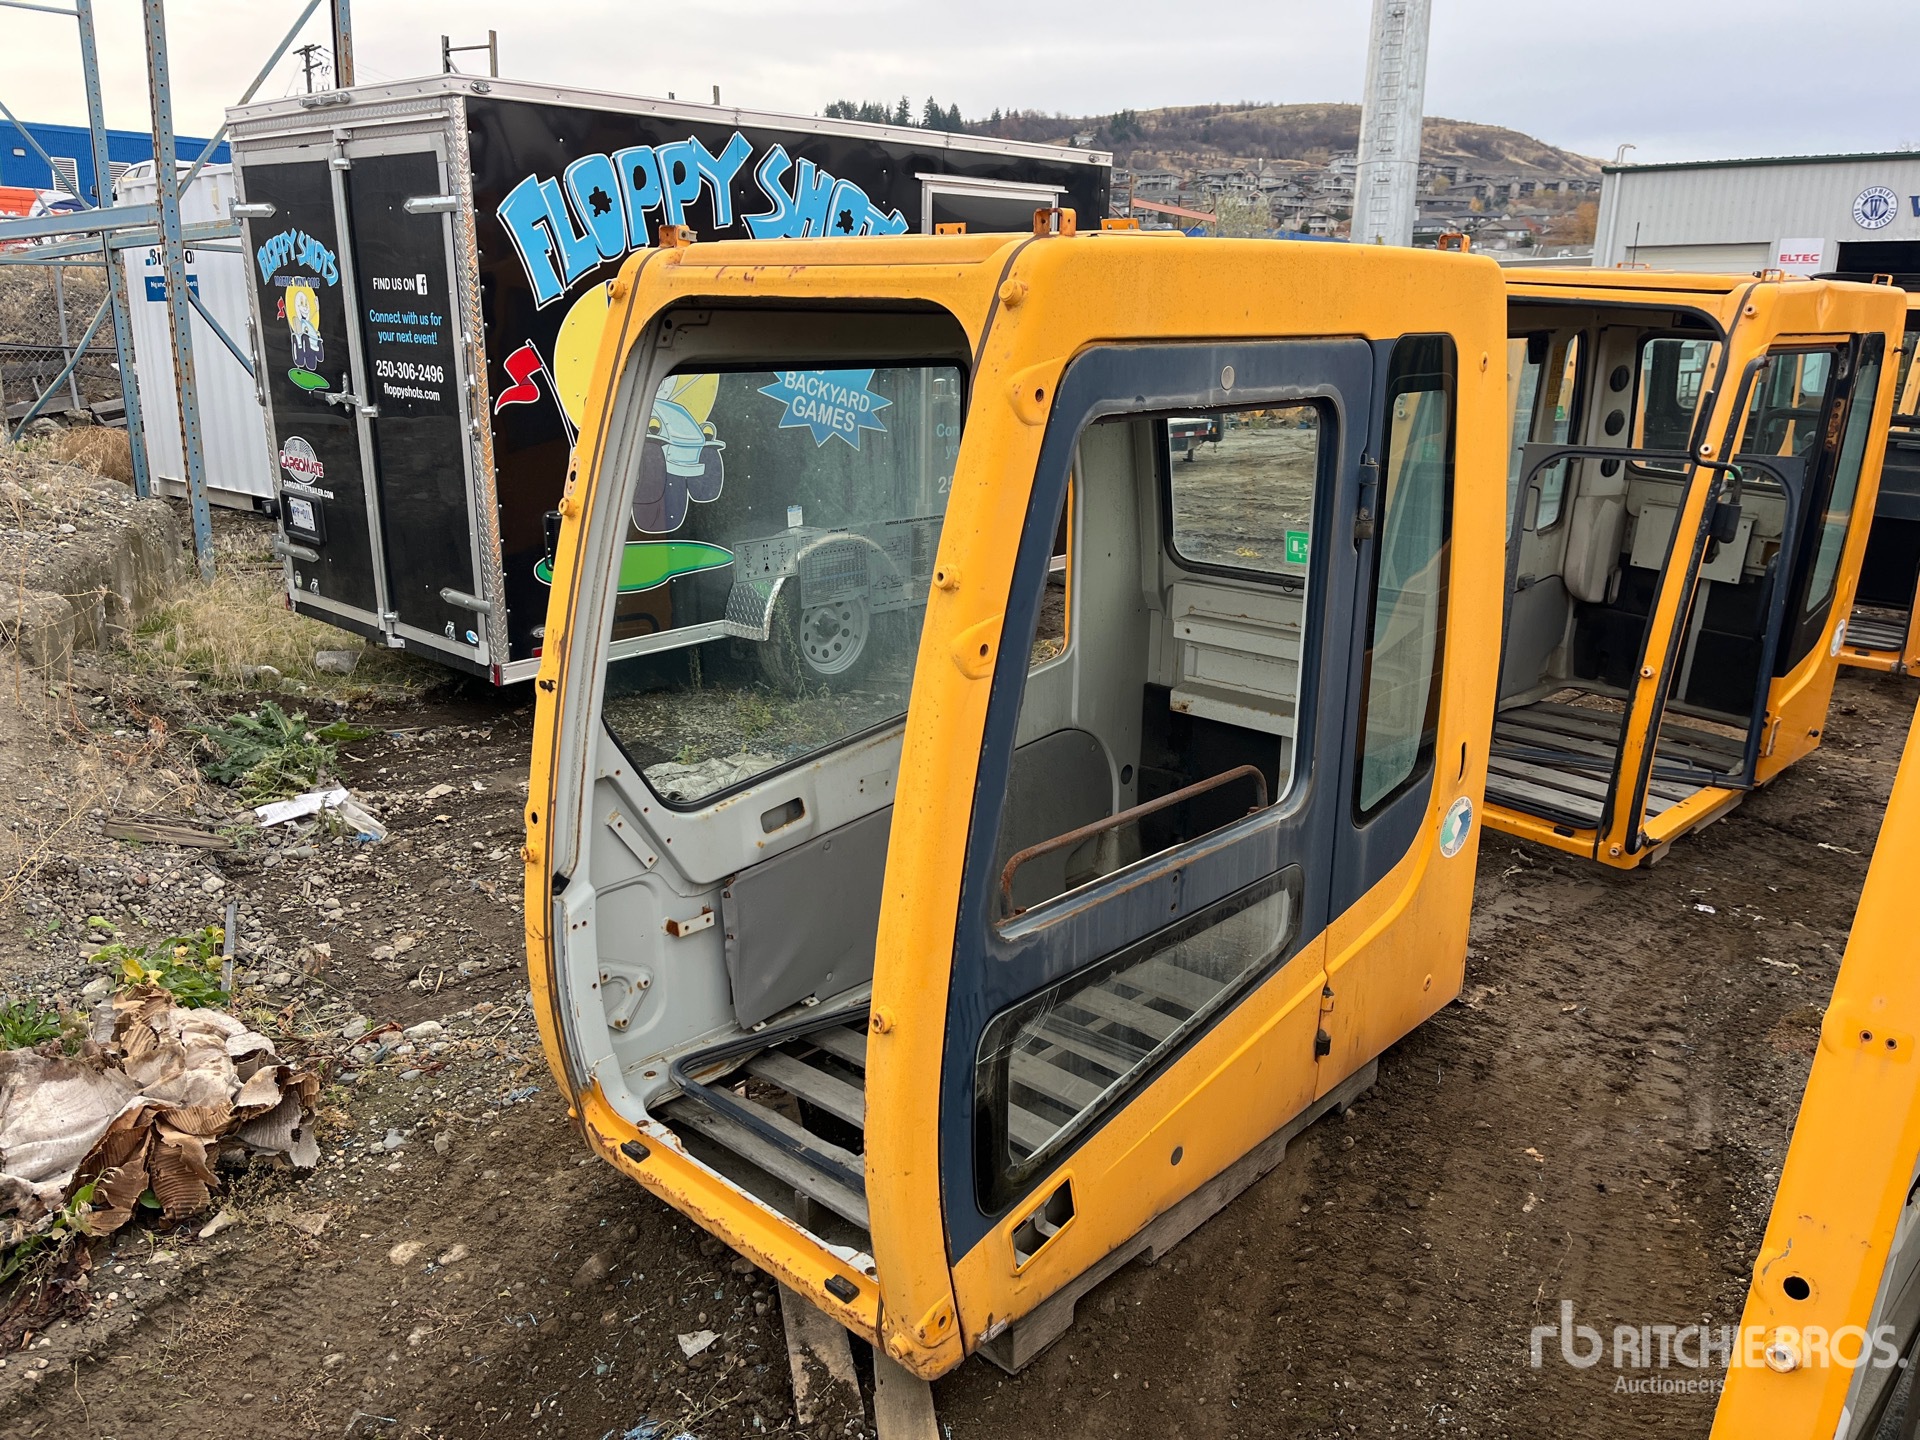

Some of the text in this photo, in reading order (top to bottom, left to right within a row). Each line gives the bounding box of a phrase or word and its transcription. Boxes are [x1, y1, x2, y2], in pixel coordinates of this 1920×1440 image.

[496, 131, 753, 310] FLOPPY
[257, 228, 339, 286] FLOPPY SHOTS
[1780, 253, 1820, 262] ELTEC
[372, 277, 391, 290] FIND
[391, 277, 402, 290] US
[403, 278, 415, 291] ON
[369, 309, 442, 326] Connect with us for
[377, 330, 438, 345] your next event!
[376, 359, 444, 383] 250-306-2496
[383, 382, 441, 401] floppyshots.com
[784, 371, 870, 413] BACKYARD
[792, 395, 856, 432] GAMES
[279, 450, 324, 478] CARGOMATE
